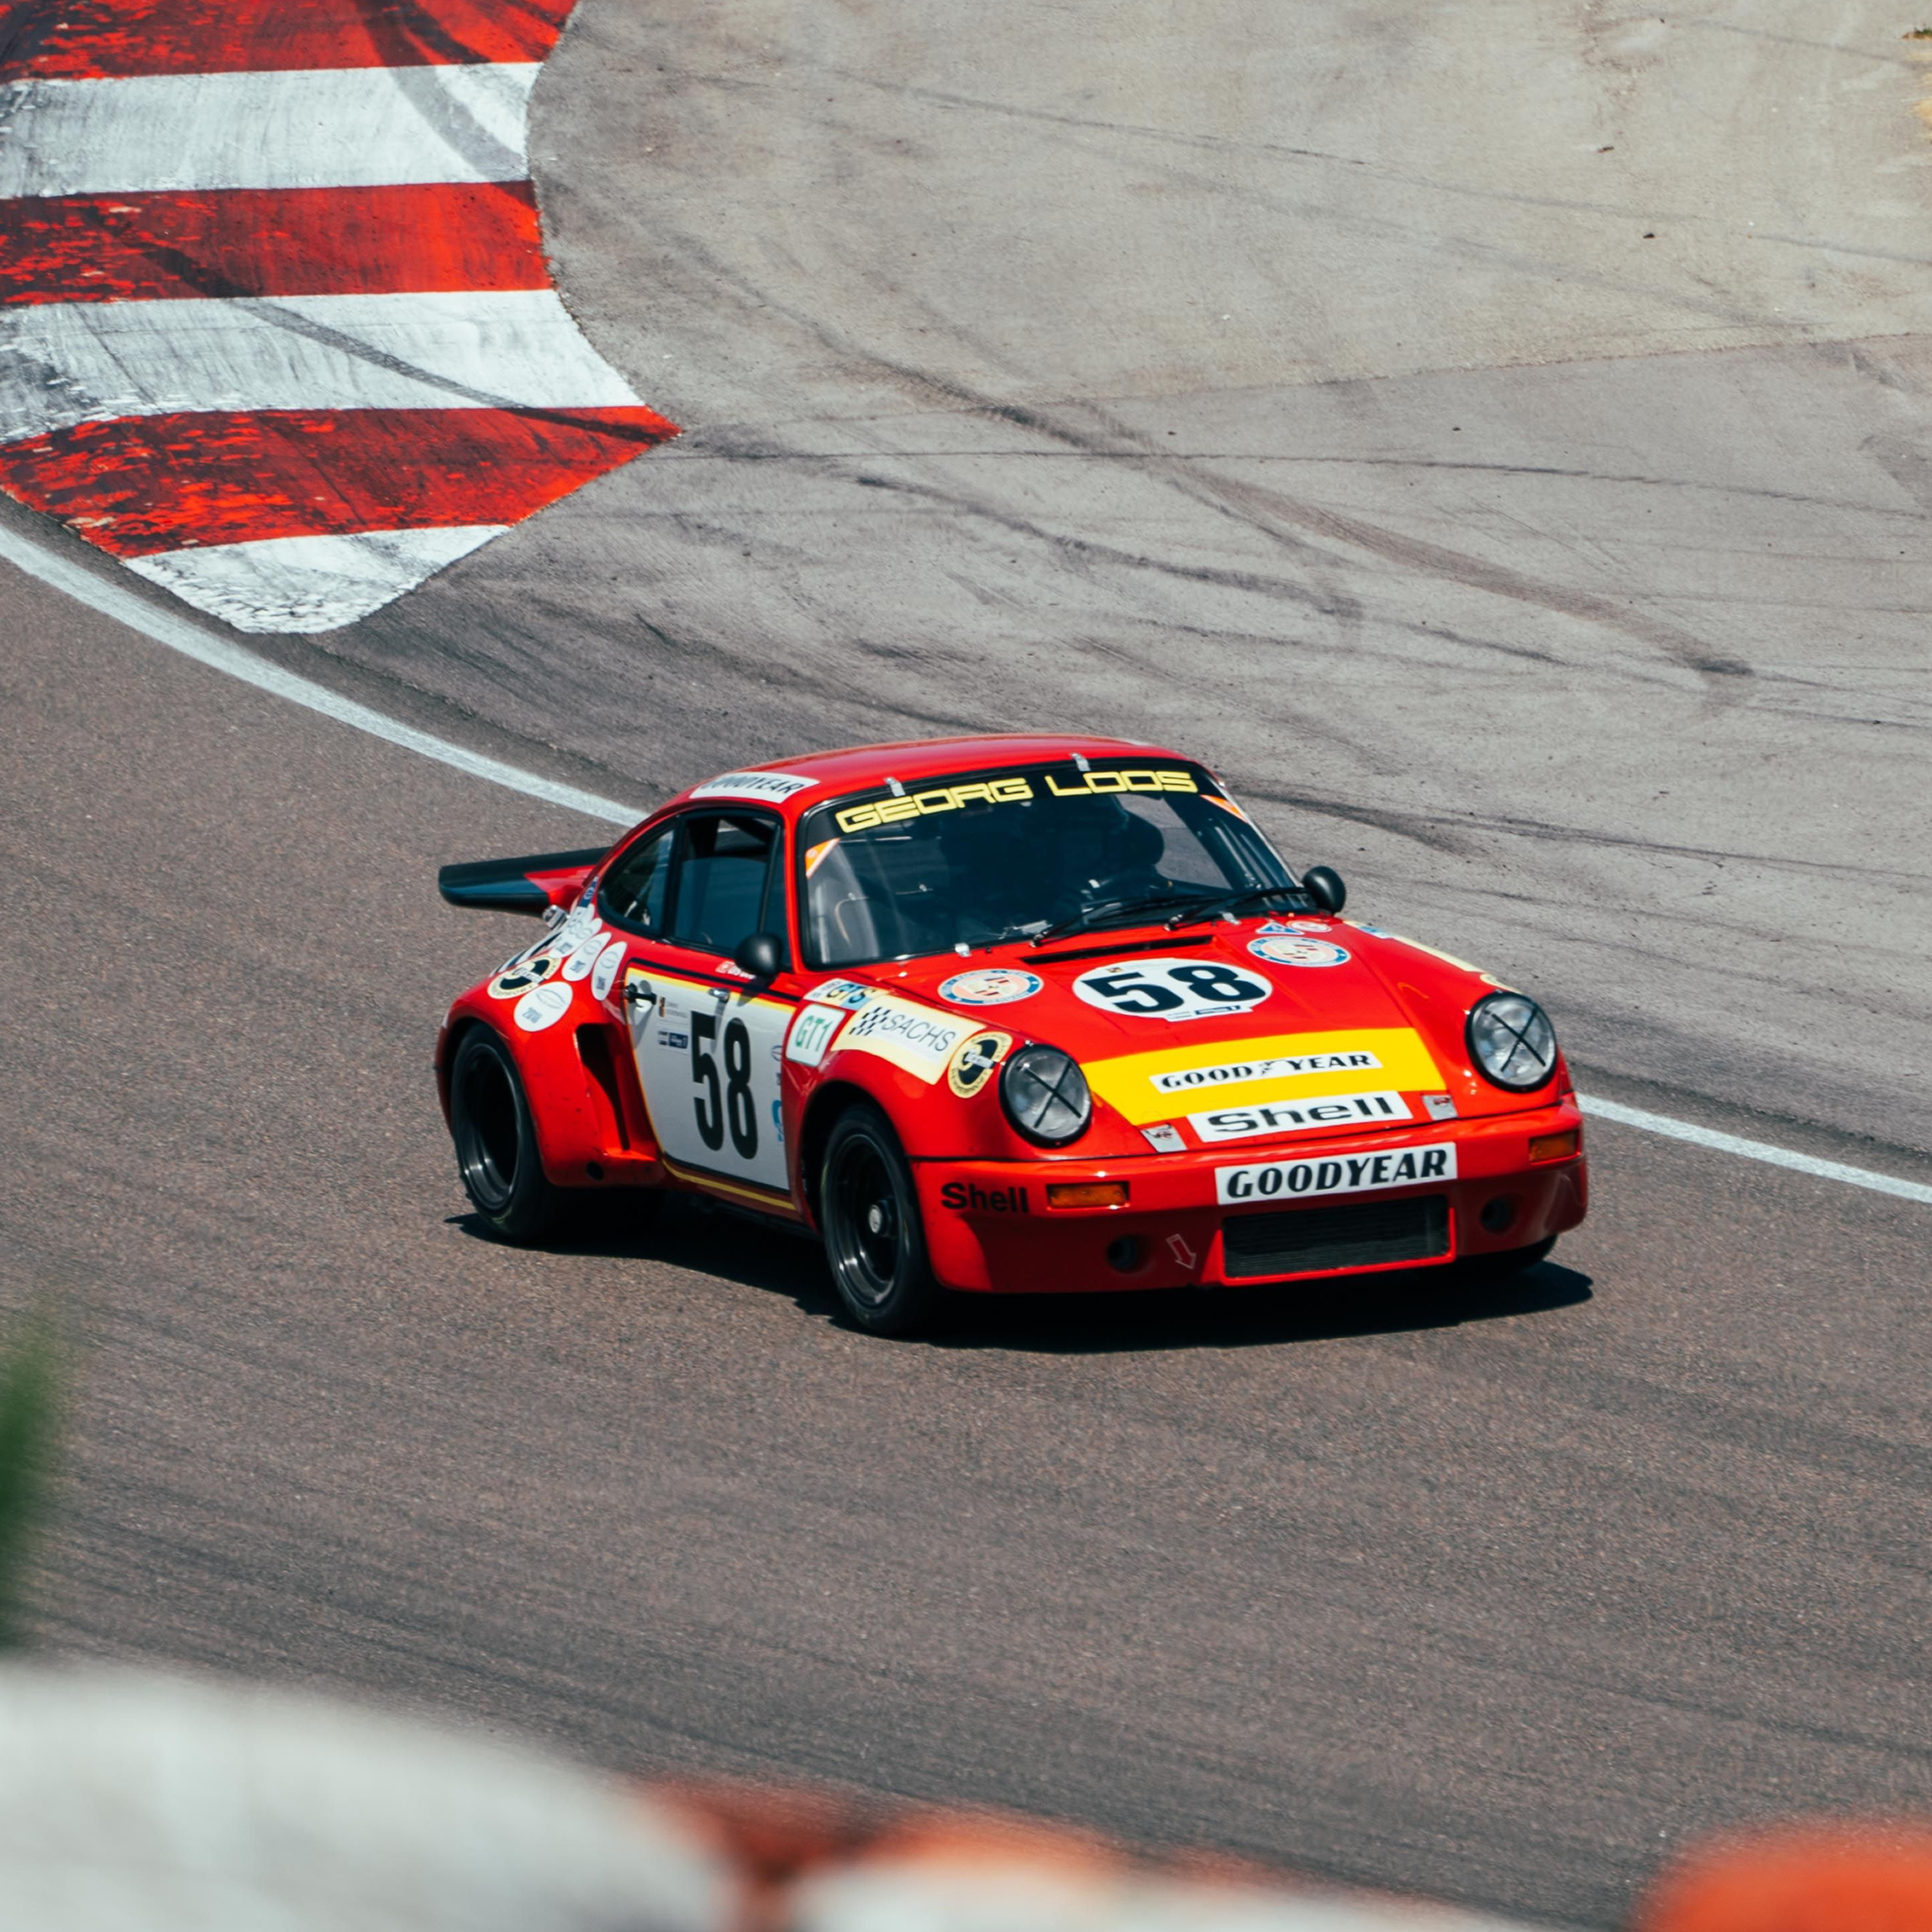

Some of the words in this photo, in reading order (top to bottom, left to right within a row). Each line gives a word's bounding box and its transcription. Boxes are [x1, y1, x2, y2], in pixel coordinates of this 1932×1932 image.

[835, 776, 1034, 834] GEORG
[1045, 770, 1198, 798] LOOS
[1081, 966, 1266, 1013] 58
[796, 1015, 834, 1051] GT1
[882, 1013, 955, 1051] SACHS
[691, 1010, 758, 1160] 58
[1208, 1097, 1395, 1132] Shell
[1226, 1149, 1447, 1199] GOODYEAR
[940, 1182, 1029, 1213] Shell
